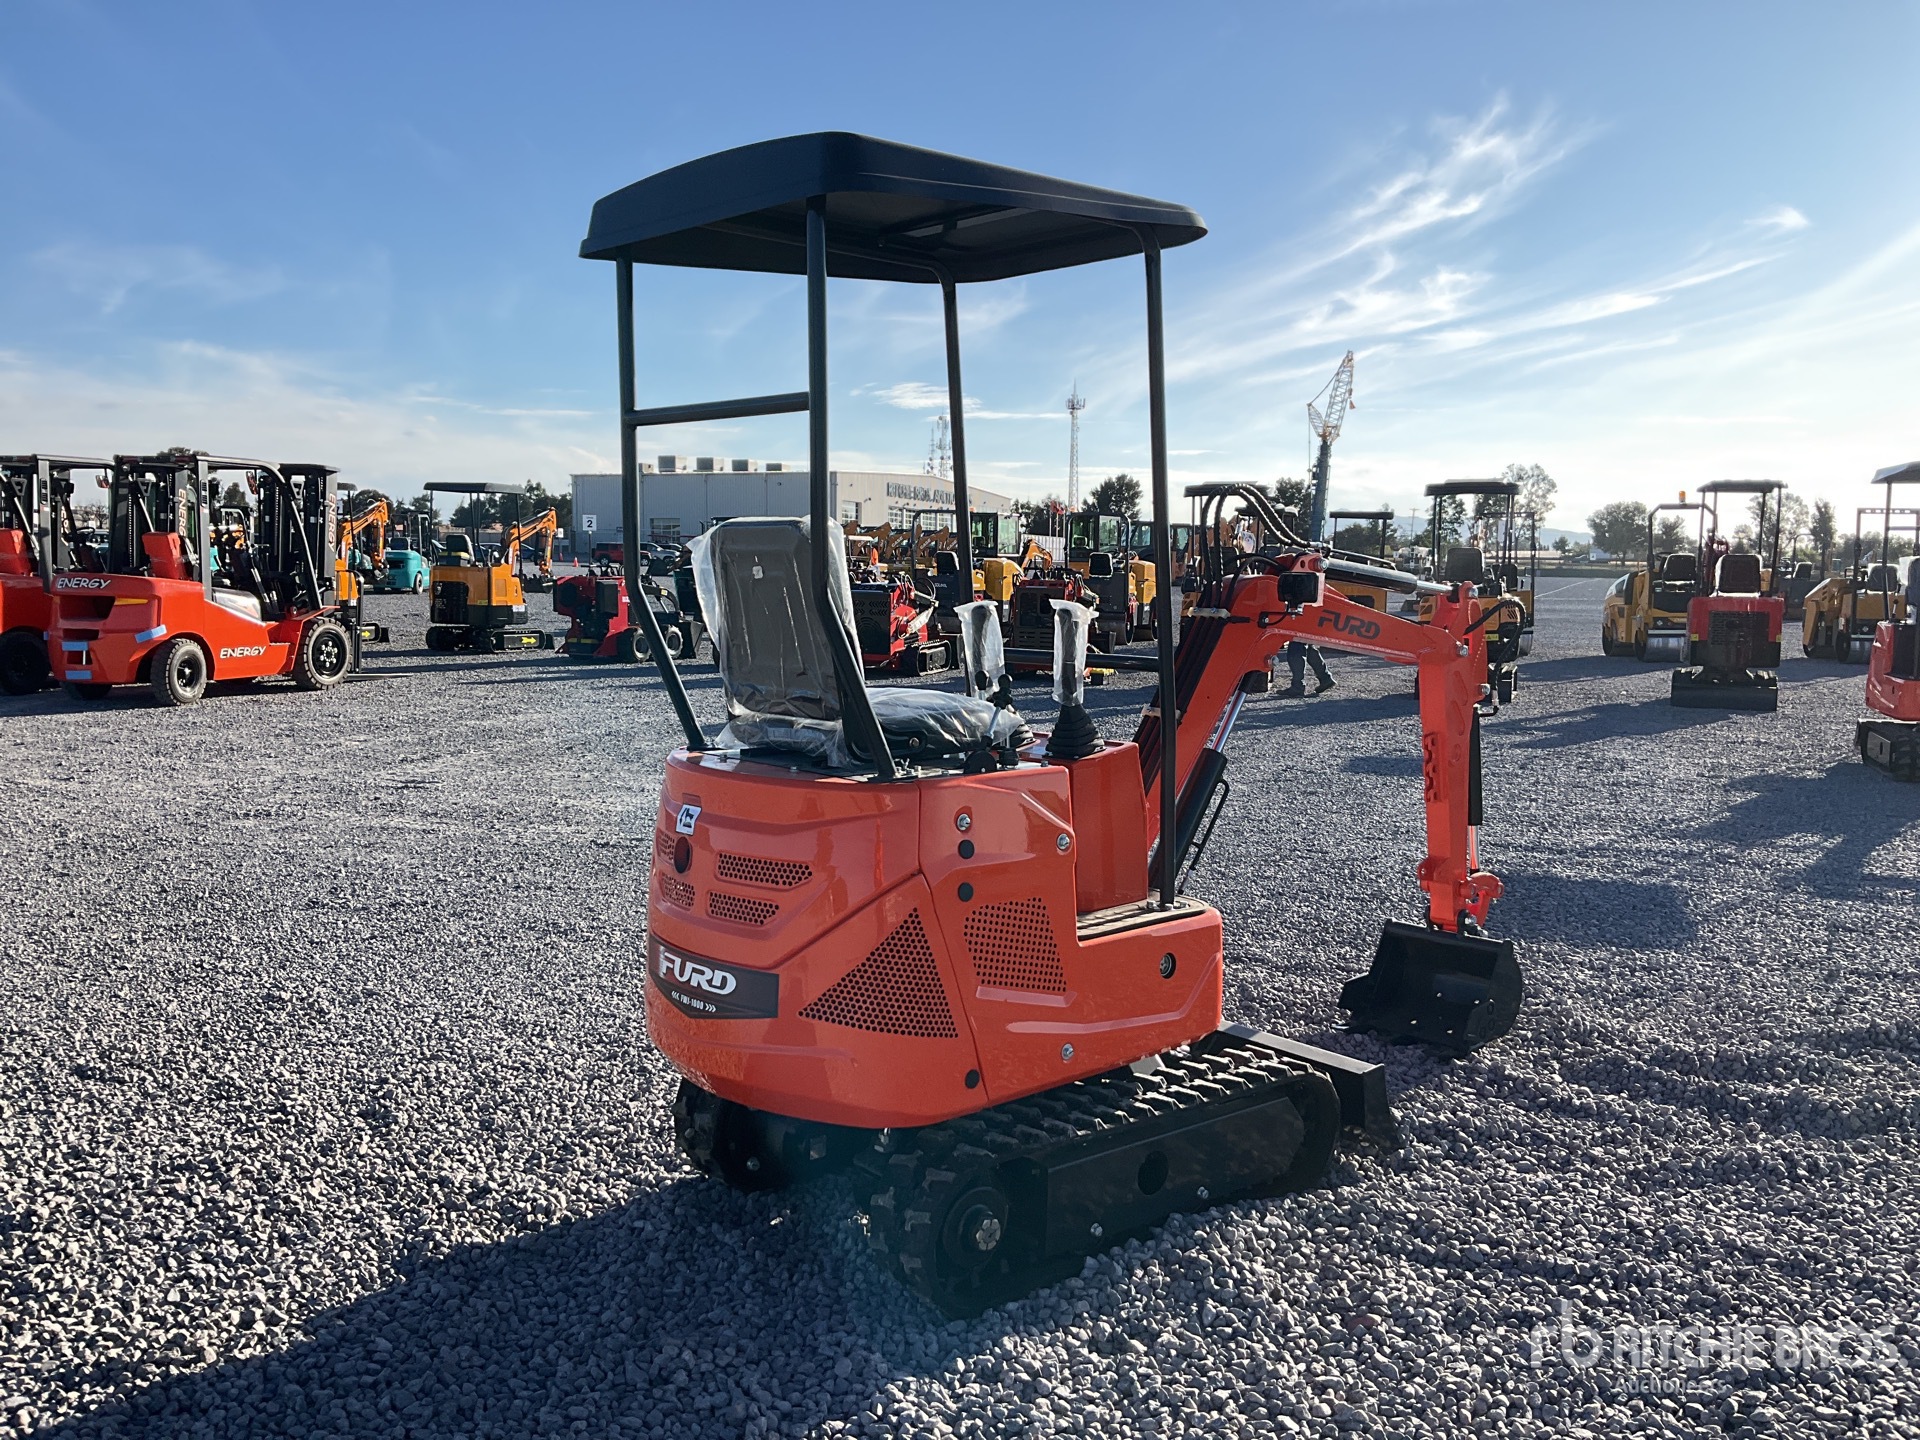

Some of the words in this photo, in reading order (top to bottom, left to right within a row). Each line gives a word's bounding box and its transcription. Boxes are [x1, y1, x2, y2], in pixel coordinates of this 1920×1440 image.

[178, 488, 187, 536] ENERG
[328, 493, 337, 552] ENERGY
[586, 519, 593, 528] 2
[56, 577, 111, 589] ENERGY
[1317, 609, 1381, 640] FURD
[219, 645, 267, 659] ENERGY
[658, 944, 737, 995] FURD
